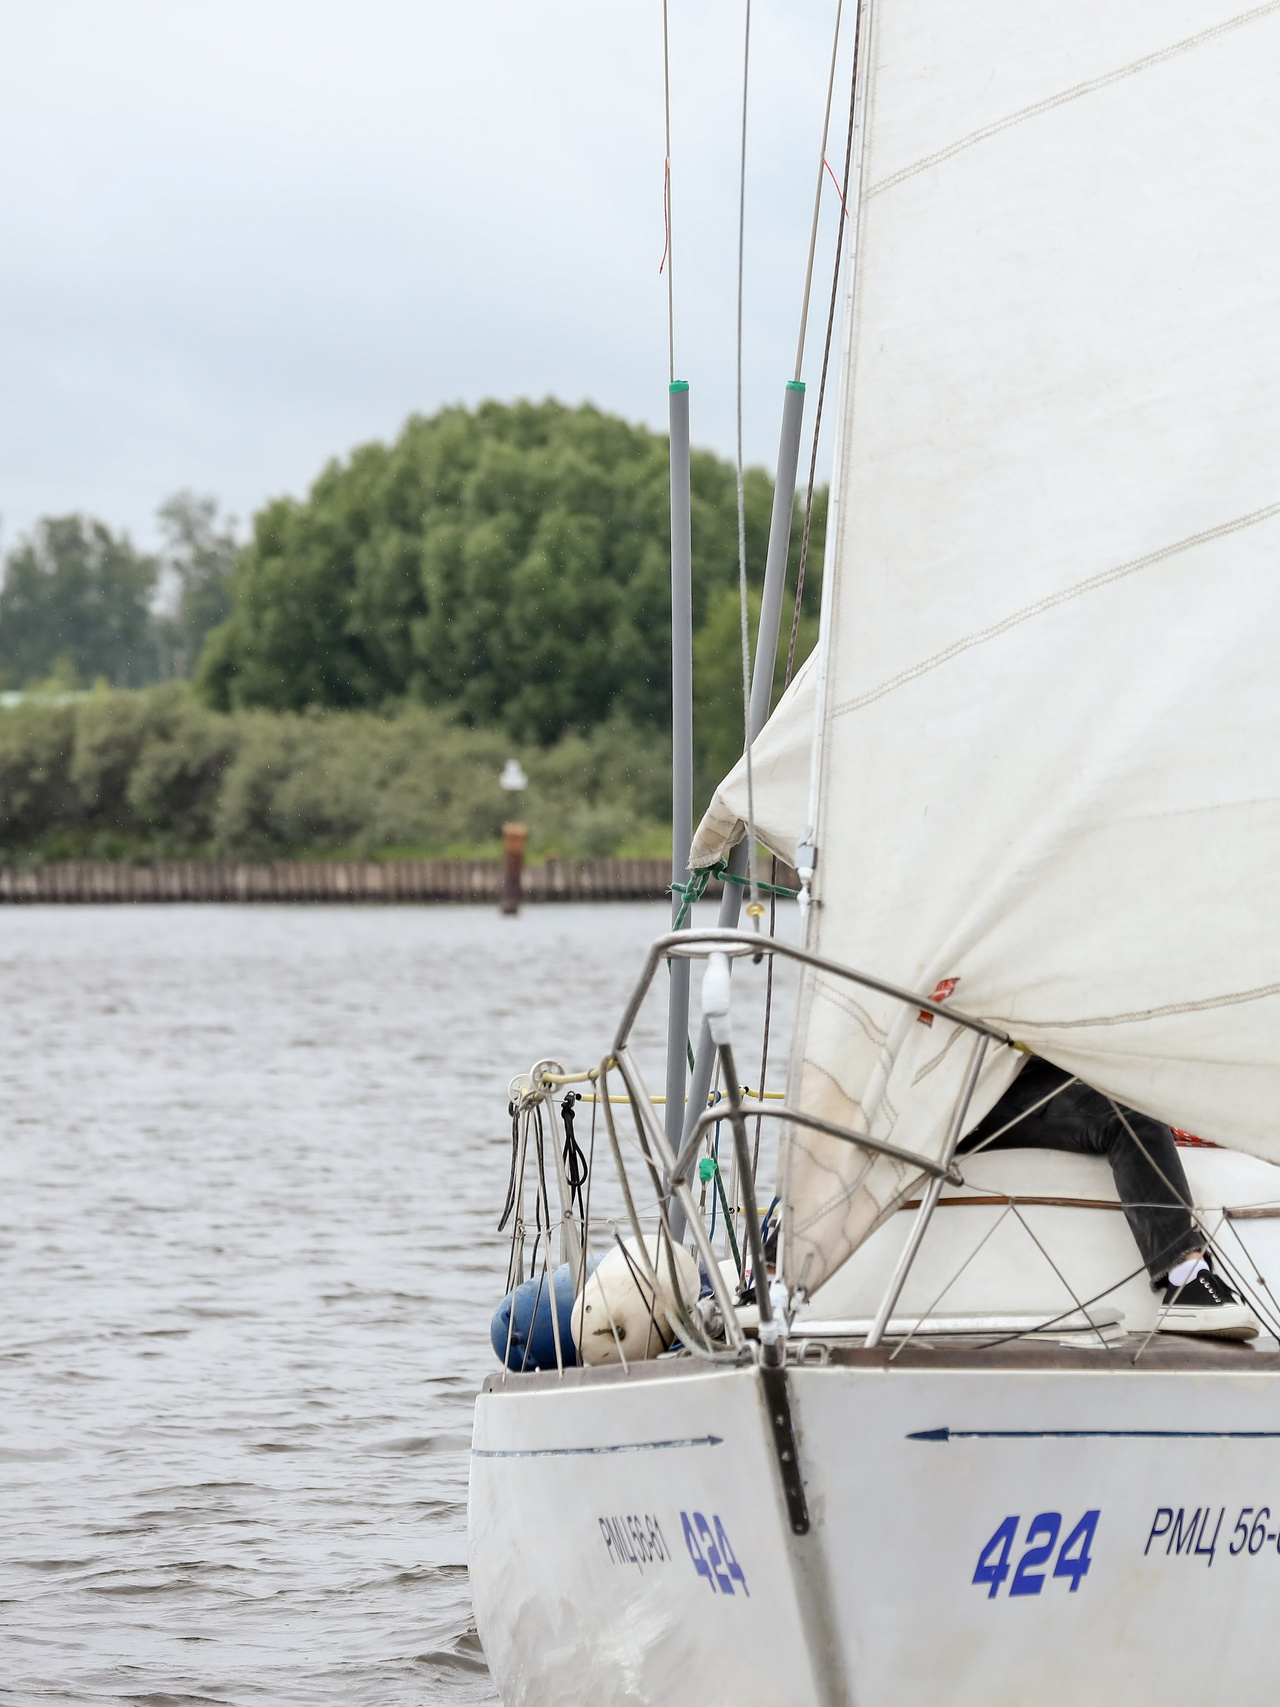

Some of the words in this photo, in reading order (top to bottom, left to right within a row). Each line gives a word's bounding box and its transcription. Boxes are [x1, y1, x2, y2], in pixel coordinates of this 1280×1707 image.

[679, 1511, 751, 1598] 424
[971, 1509, 1102, 1600] 424
[1144, 1507, 1226, 1567] РМЦ
